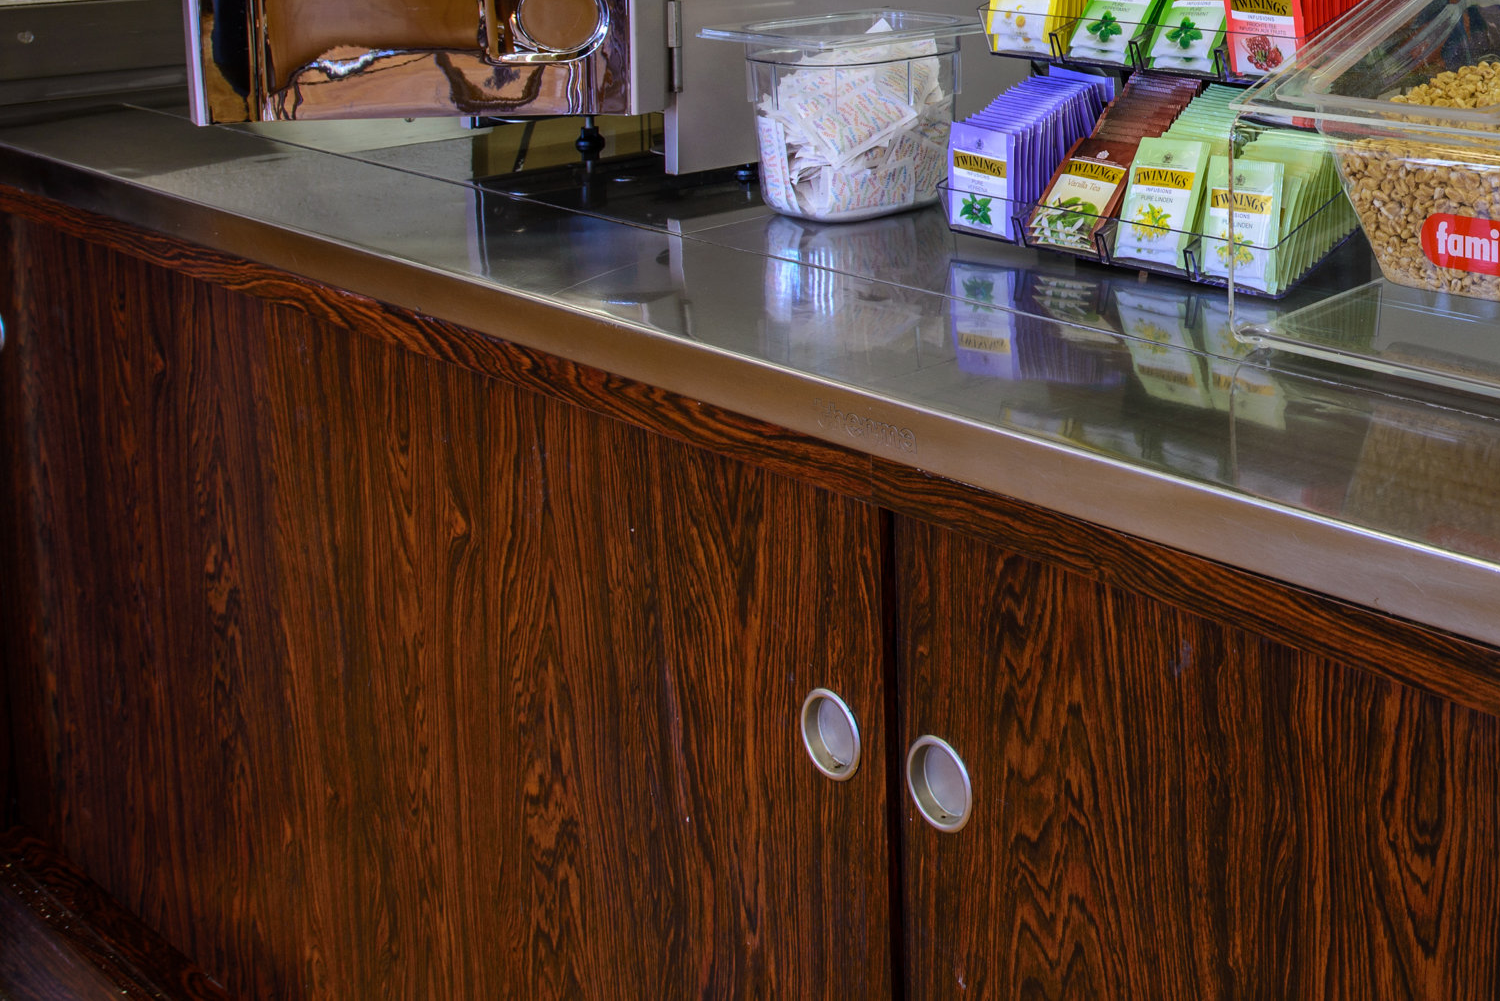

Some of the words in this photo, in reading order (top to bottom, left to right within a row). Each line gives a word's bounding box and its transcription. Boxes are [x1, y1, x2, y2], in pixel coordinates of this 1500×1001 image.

[955, 155, 1003, 176] TWININGS
[1068, 163, 1118, 182] TWININGS
[1068, 178, 1088, 190] Vanilla
[1088, 182, 1101, 192] Tea
[1136, 170, 1189, 188] TWININGS
[1154, 196, 1173, 204] LINDEN
[1214, 194, 1266, 212] TWNINGS
[812, 398, 917, 455] therma
